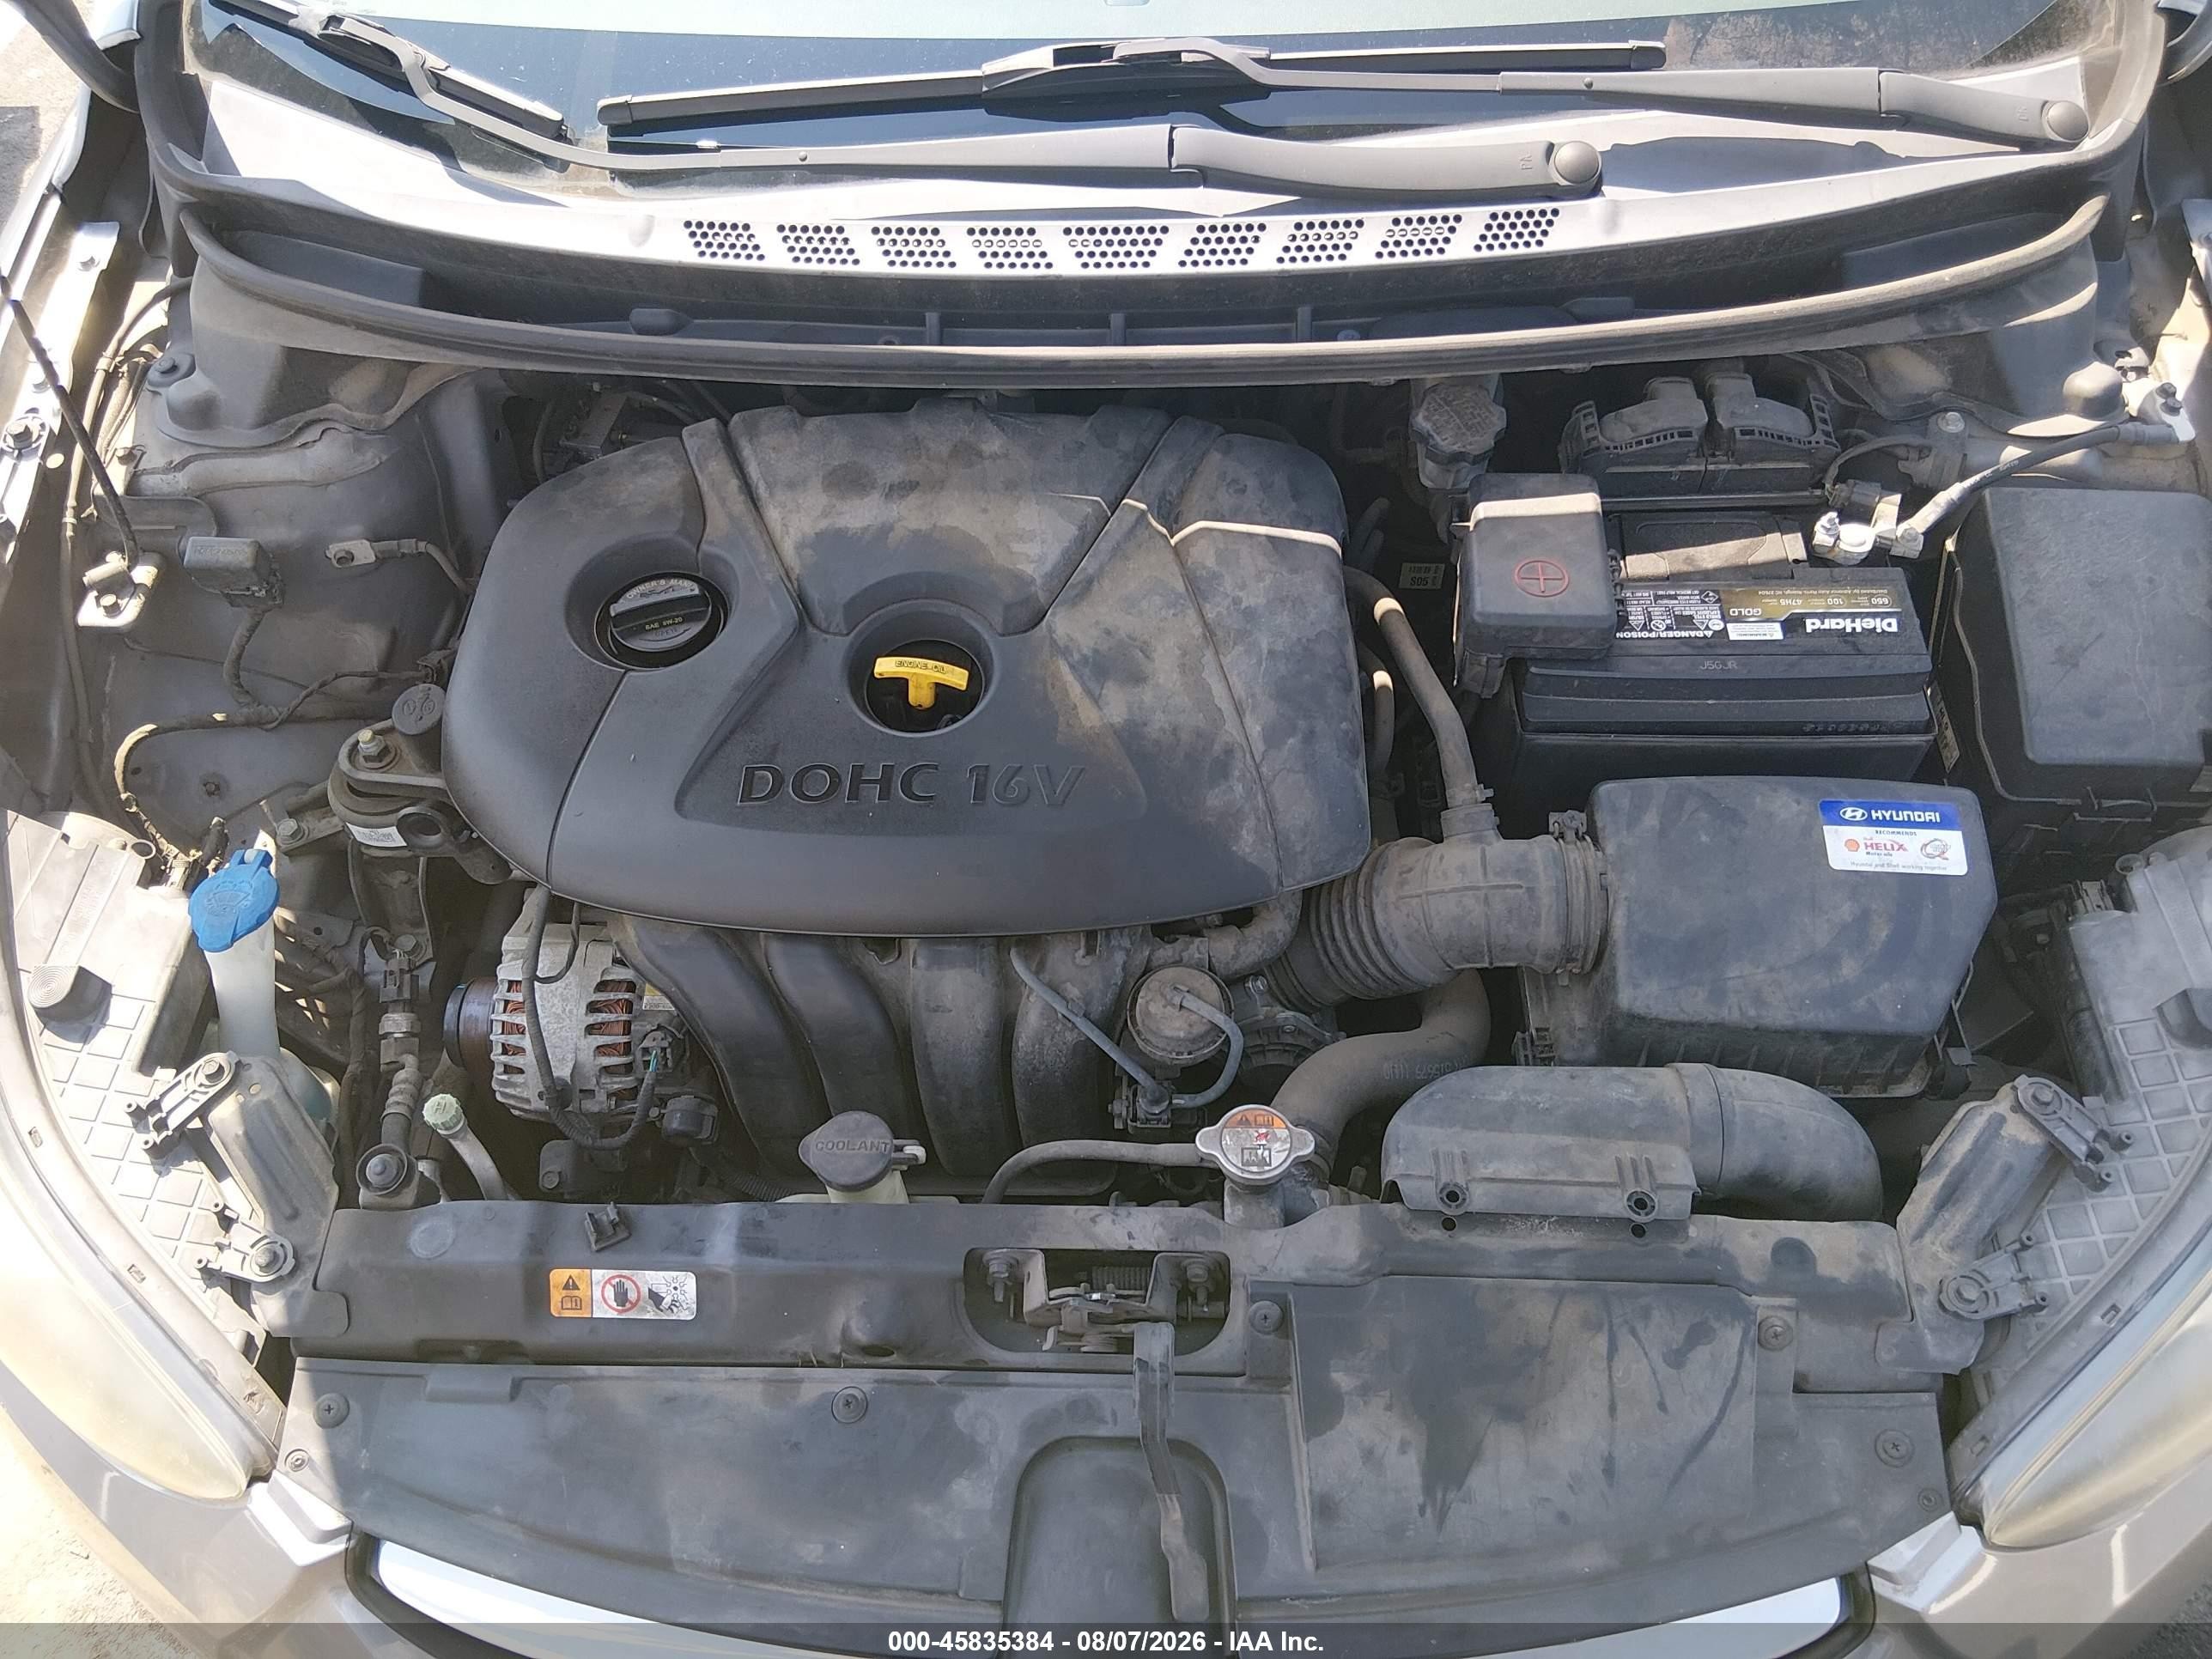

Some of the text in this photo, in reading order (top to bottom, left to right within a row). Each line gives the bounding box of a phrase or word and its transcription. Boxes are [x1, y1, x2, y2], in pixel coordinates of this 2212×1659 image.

[627, 579, 665, 599] OWNER'S
[1729, 607, 1762, 617] GOLD
[645, 622, 660, 630] SAE
[1805, 617, 1899, 634] DieHard
[895, 659, 947, 674] ENGINE OIL
[736, 763, 1087, 806] DOHC 16V
[1870, 809, 1941, 823] HYUNDAI
[1864, 842, 1908, 852] HELIX
[816, 1139, 891, 1153] COOLANT
